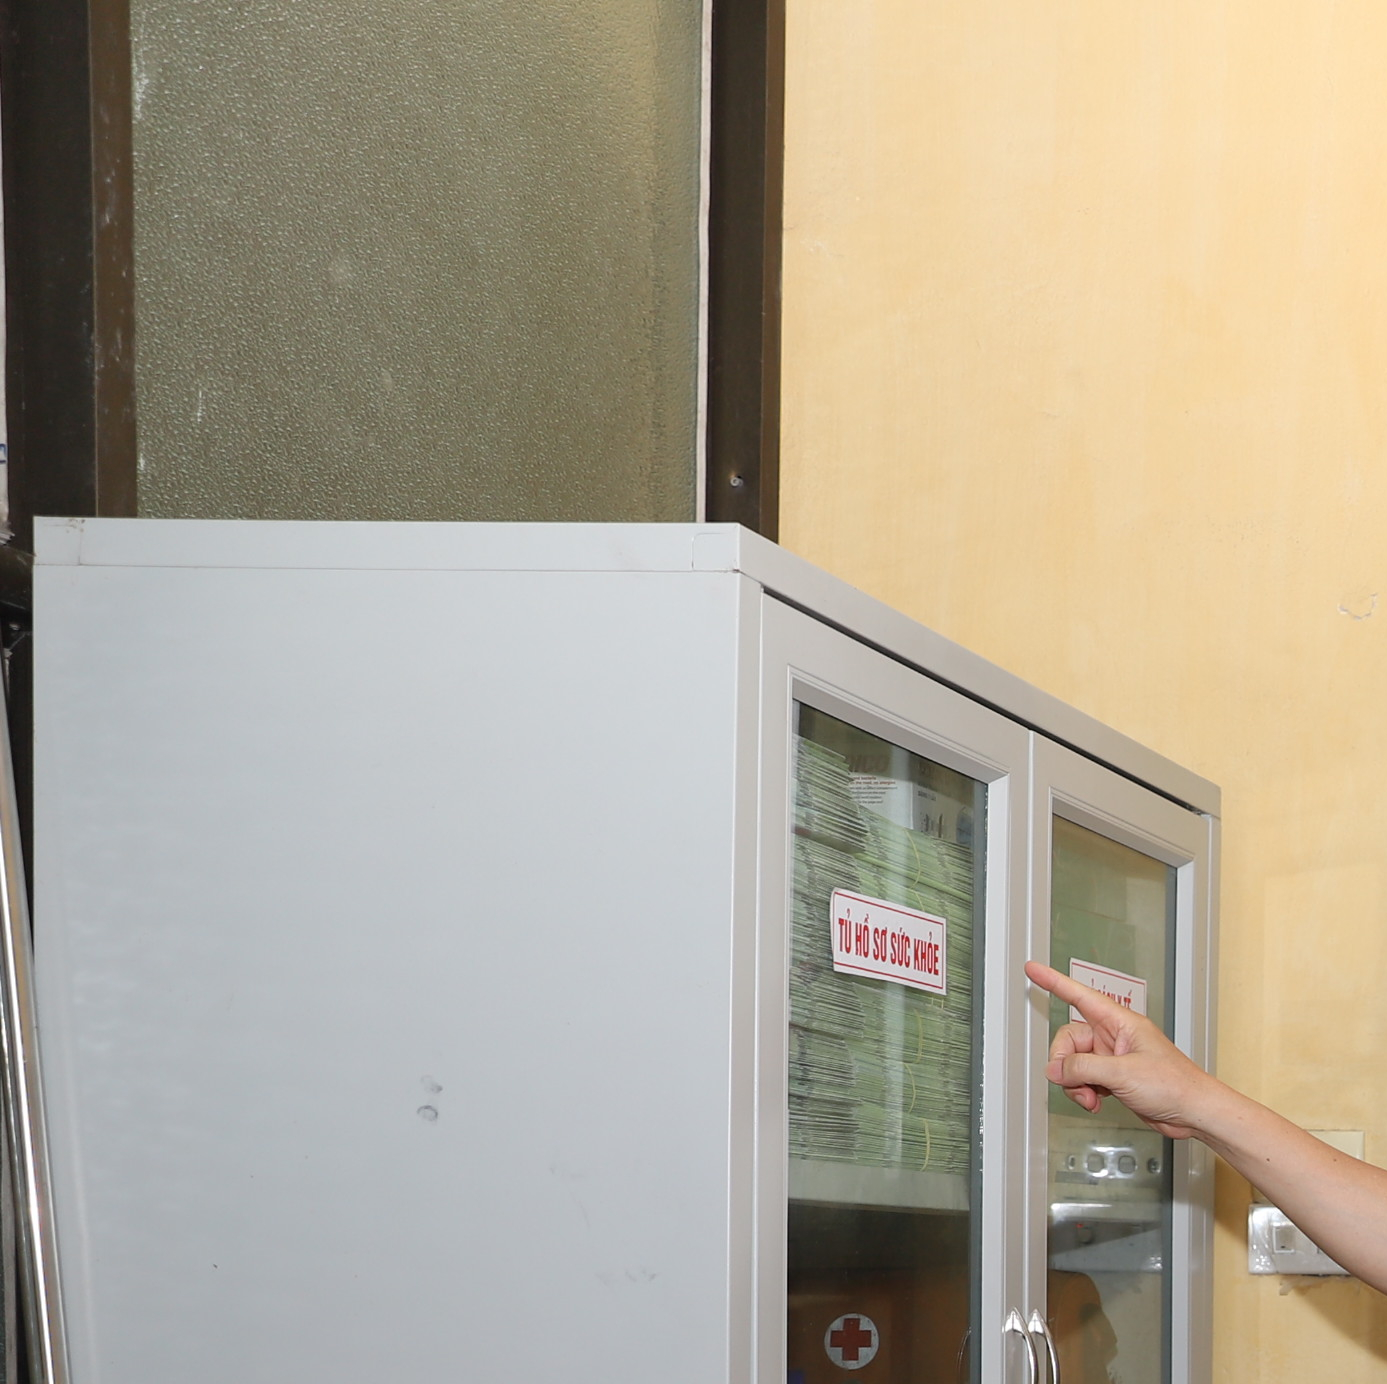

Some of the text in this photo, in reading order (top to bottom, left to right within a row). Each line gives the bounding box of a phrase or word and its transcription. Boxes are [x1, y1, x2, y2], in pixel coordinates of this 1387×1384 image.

[838, 908, 852, 954] TỦ
[873, 926, 887, 962] SƠ
[890, 927, 910, 968] SỨC
[914, 931, 939, 976] KHỎE
